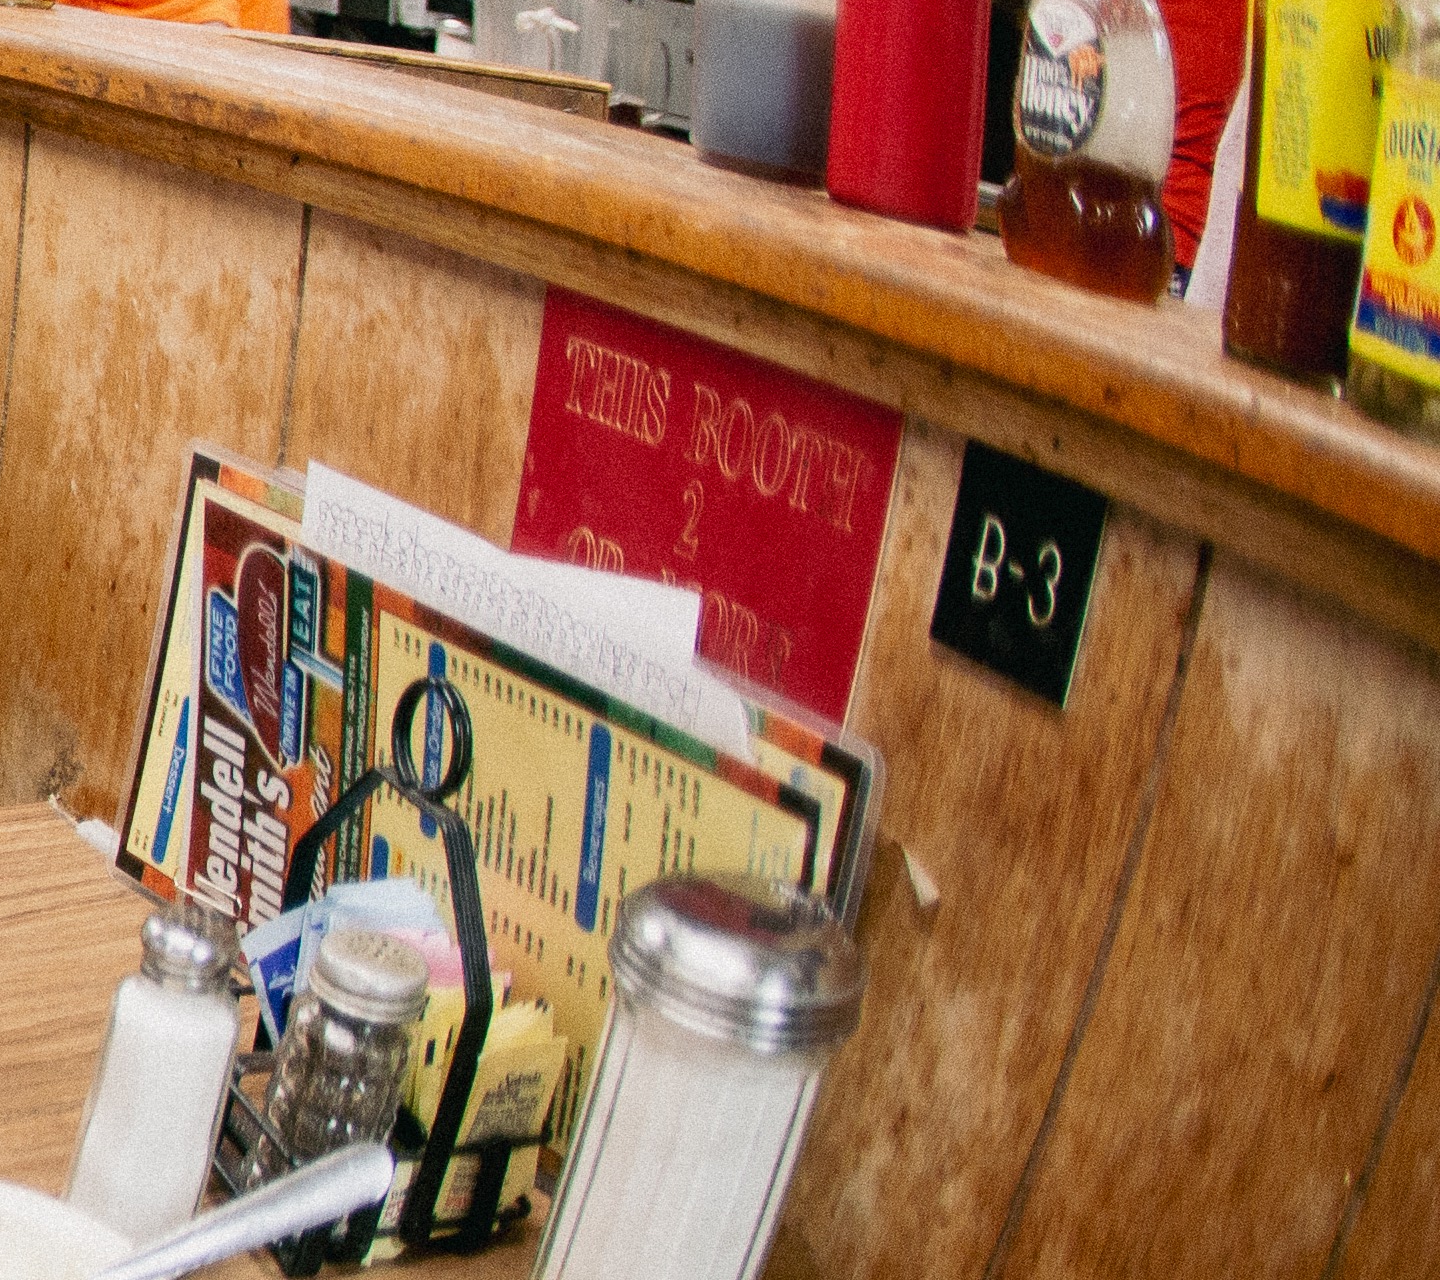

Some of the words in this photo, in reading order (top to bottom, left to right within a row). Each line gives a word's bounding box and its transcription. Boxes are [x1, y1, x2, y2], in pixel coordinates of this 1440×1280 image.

[565, 334, 671, 445] THIS
[684, 380, 877, 533] BOOTH
[674, 479, 704, 561] 2
[972, 513, 1065, 628] B-3
[209, 607, 224, 689] FINE
[223, 613, 239, 693] FOOD
[293, 580, 314, 645] EAT
[161, 746, 185, 814] Dessert
